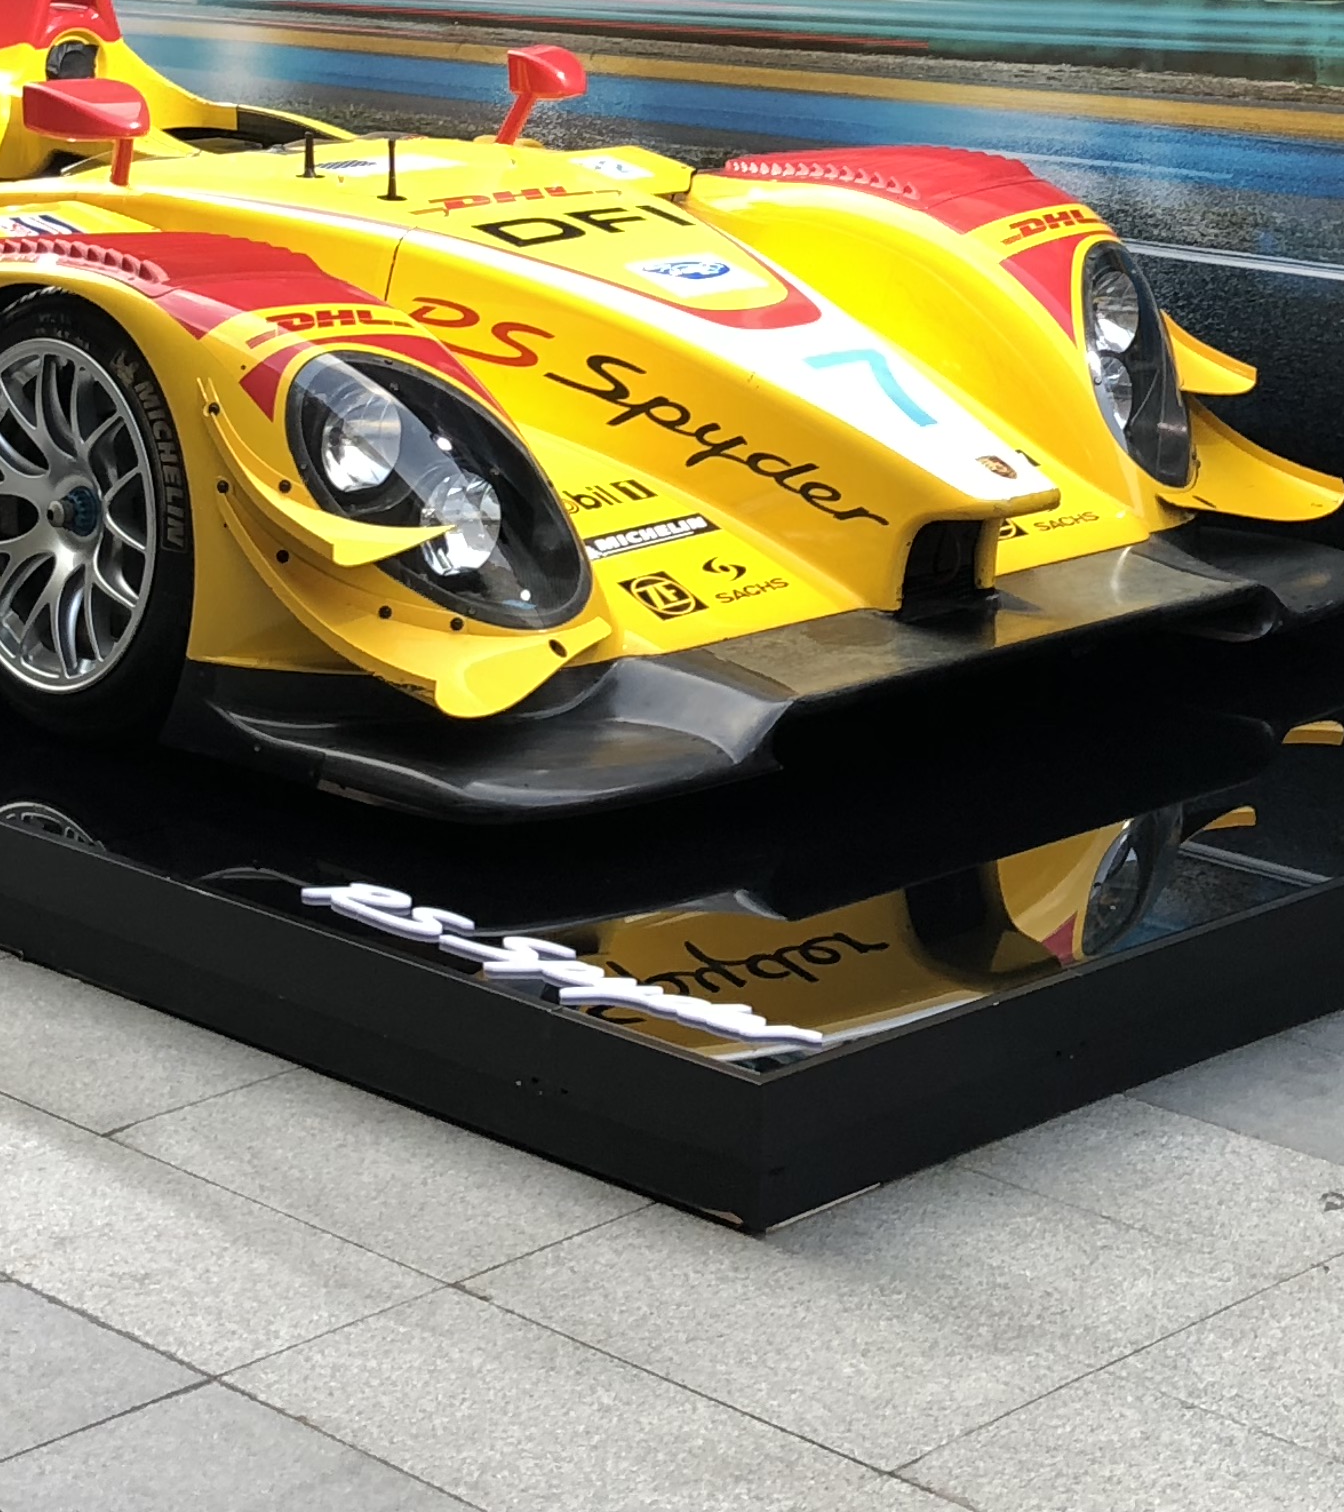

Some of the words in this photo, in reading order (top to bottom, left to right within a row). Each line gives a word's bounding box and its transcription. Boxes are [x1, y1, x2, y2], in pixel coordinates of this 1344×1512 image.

[428, 185, 594, 210] DHL
[472, 205, 696, 248] DFI
[1008, 209, 1105, 237] DHL
[265, 309, 415, 332] DHL
[802, 348, 938, 427] 7
[544, 355, 890, 527] Spyder
[134, 380, 185, 549] MICHELIN
[561, 484, 624, 515] obil
[594, 516, 708, 553] MICHELIN
[1033, 511, 1100, 532] SACHS
[634, 581, 692, 611] ZF
[715, 578, 790, 604] SACHS
